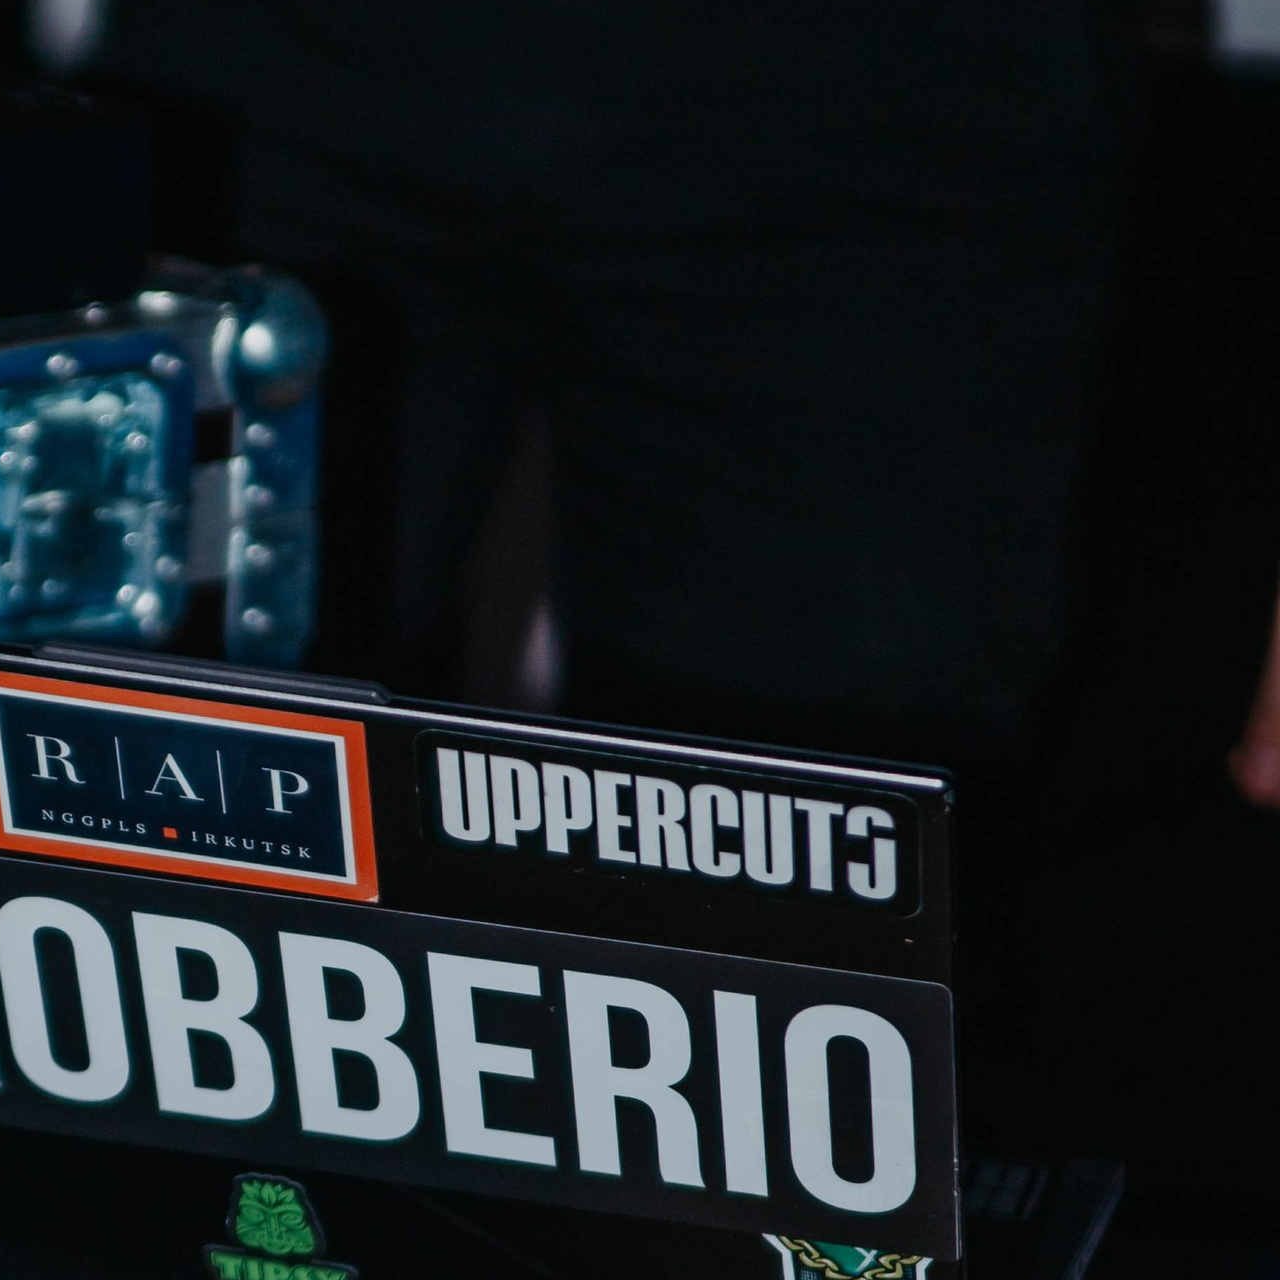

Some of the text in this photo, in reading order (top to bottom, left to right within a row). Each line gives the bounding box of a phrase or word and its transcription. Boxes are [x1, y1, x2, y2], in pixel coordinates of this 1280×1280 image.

[41, 809, 312, 860] NGGPLS IRKUTSK
[436, 746, 898, 901] UPPERCUTS
